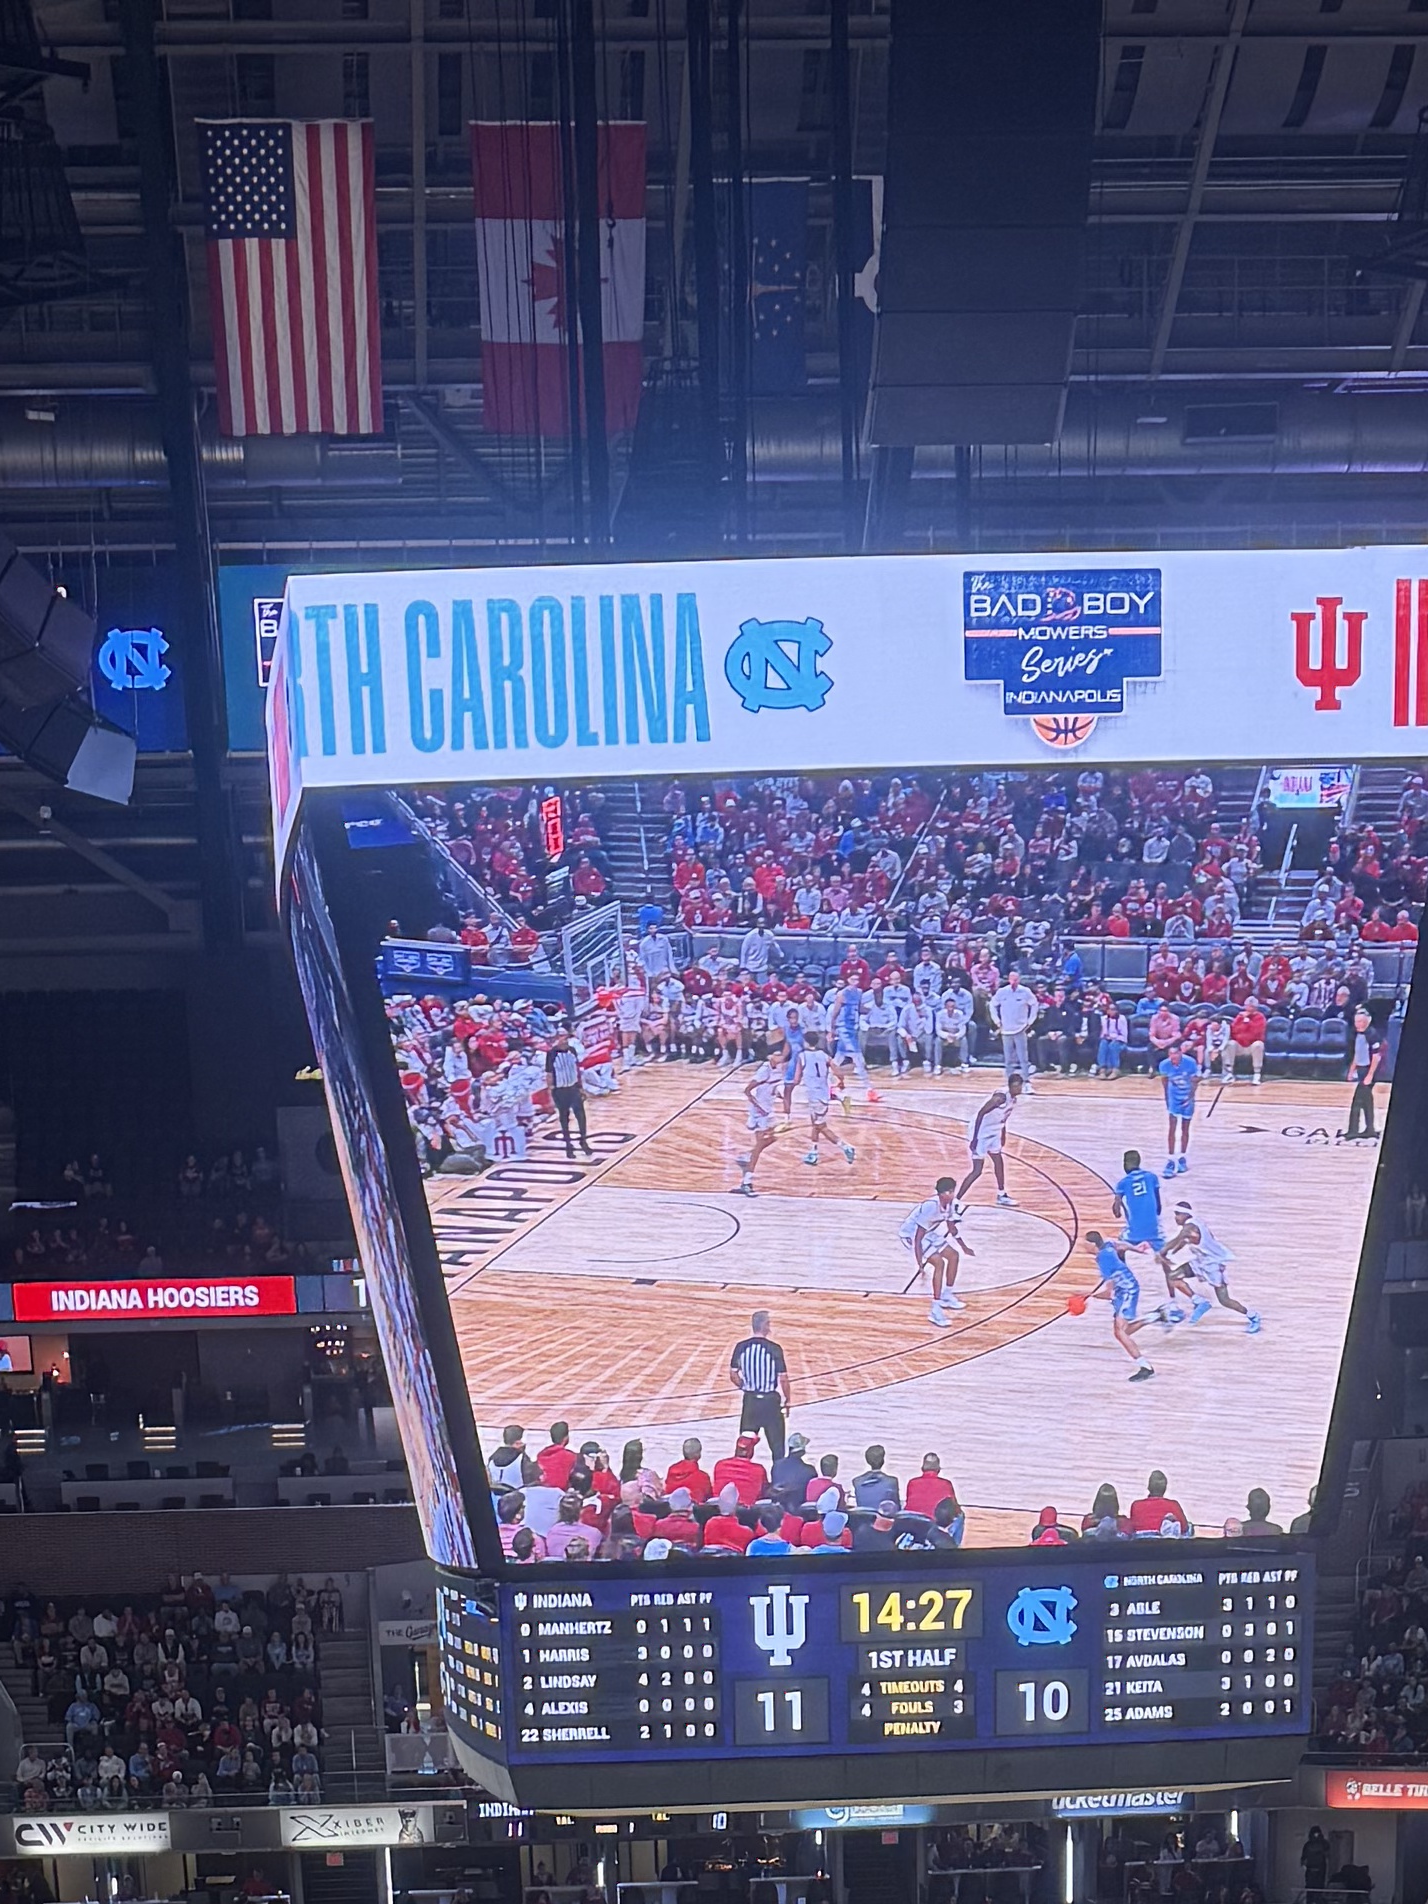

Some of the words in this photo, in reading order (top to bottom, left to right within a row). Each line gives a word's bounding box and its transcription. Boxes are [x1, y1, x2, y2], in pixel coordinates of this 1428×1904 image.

[969, 593, 1040, 618] BAD
[1083, 591, 1155, 617] BOY
[1018, 625, 1107, 640] MOWERS
[405, 592, 712, 754] CAROLINA
[1020, 647, 1108, 684] Series
[1005, 688, 1122, 705] INDIANAPOLIS
[1132, 1181, 1148, 1196] 21
[51, 1288, 144, 1311] INDIANA
[147, 1285, 260, 1309] HOOSIERS
[532, 1592, 593, 1609] INDIANA
[852, 1589, 972, 1634] 14:27
[538, 1620, 612, 1637] MANHERTZ
[1126, 1625, 1205, 1642] STEVENSON
[522, 1650, 531, 1664] 1
[539, 1647, 590, 1664] HARRIS
[869, 1649, 904, 1669] 1ST
[908, 1647, 957, 1667] HALF
[1106, 1655, 1122, 1670] 17
[522, 1675, 533, 1691] 2
[540, 1674, 598, 1690] LINDSAY
[860, 1681, 871, 1697] 4
[879, 1680, 945, 1696] TIMEOUTS
[954, 1679, 964, 1694] 4
[1126, 1679, 1163, 1696] KEITA
[524, 1701, 535, 1716] 4
[541, 1700, 589, 1716] ALEXIS
[860, 1702, 871, 1718] 4
[891, 1700, 934, 1715] FOULS
[953, 1699, 964, 1715] 3
[1018, 1680, 1070, 1722] 10
[757, 1690, 803, 1732] 11
[1104, 1706, 1122, 1722] 25
[1125, 1704, 1173, 1721] ADAMS
[521, 1728, 540, 1743] 22
[542, 1724, 611, 1742] SHERRELL
[884, 1720, 941, 1736] PENALTY
[1362, 1783, 1404, 1798] BELLE
[77, 1823, 116, 1836] CITY
[123, 1820, 168, 1833] WIDE
[332, 1816, 384, 1831] XIBER
